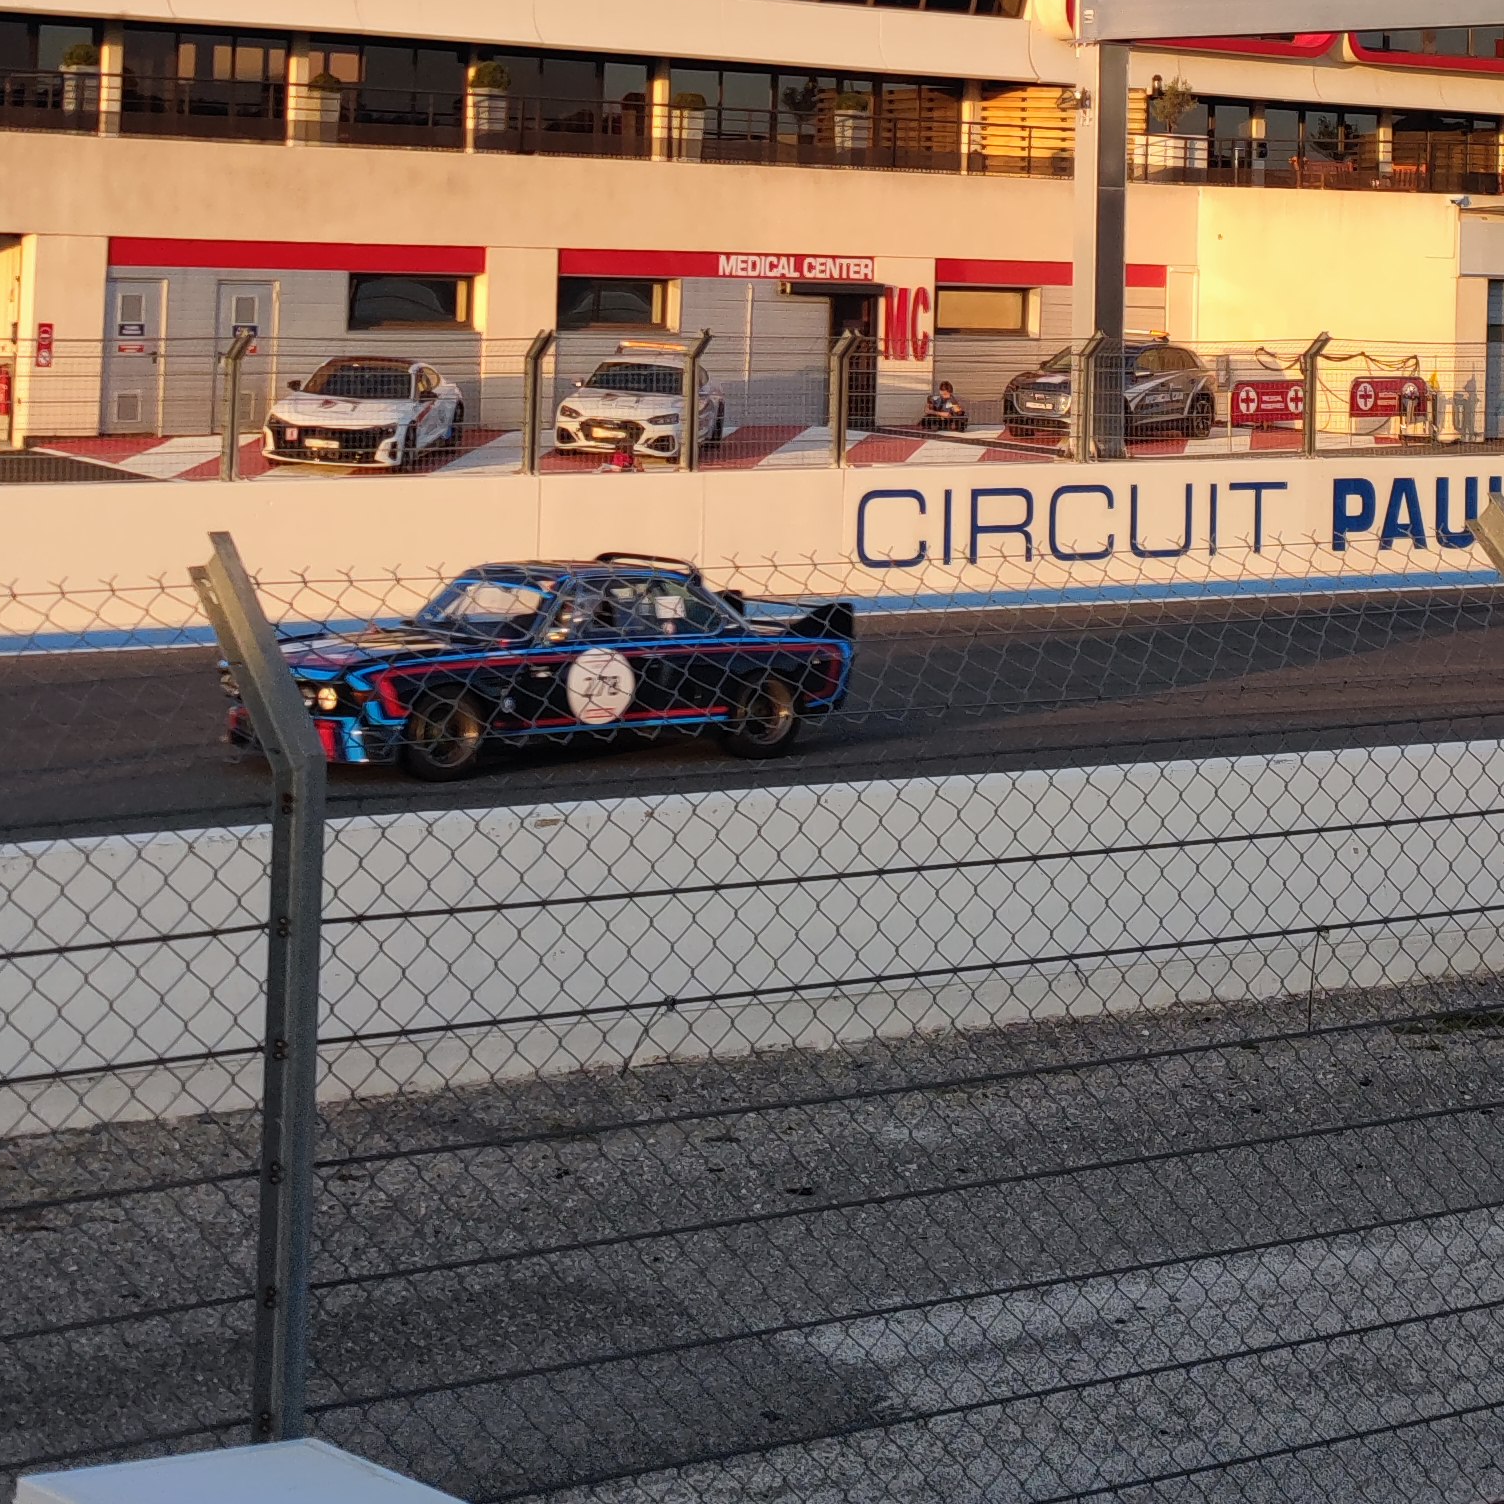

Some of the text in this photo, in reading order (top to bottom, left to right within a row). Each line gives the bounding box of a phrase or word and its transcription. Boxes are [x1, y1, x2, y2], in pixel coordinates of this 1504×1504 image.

[718, 255, 873, 280] MEDICAL CENTER
[885, 286, 930, 362] MC
[857, 482, 1288, 569] CIRCUIT
